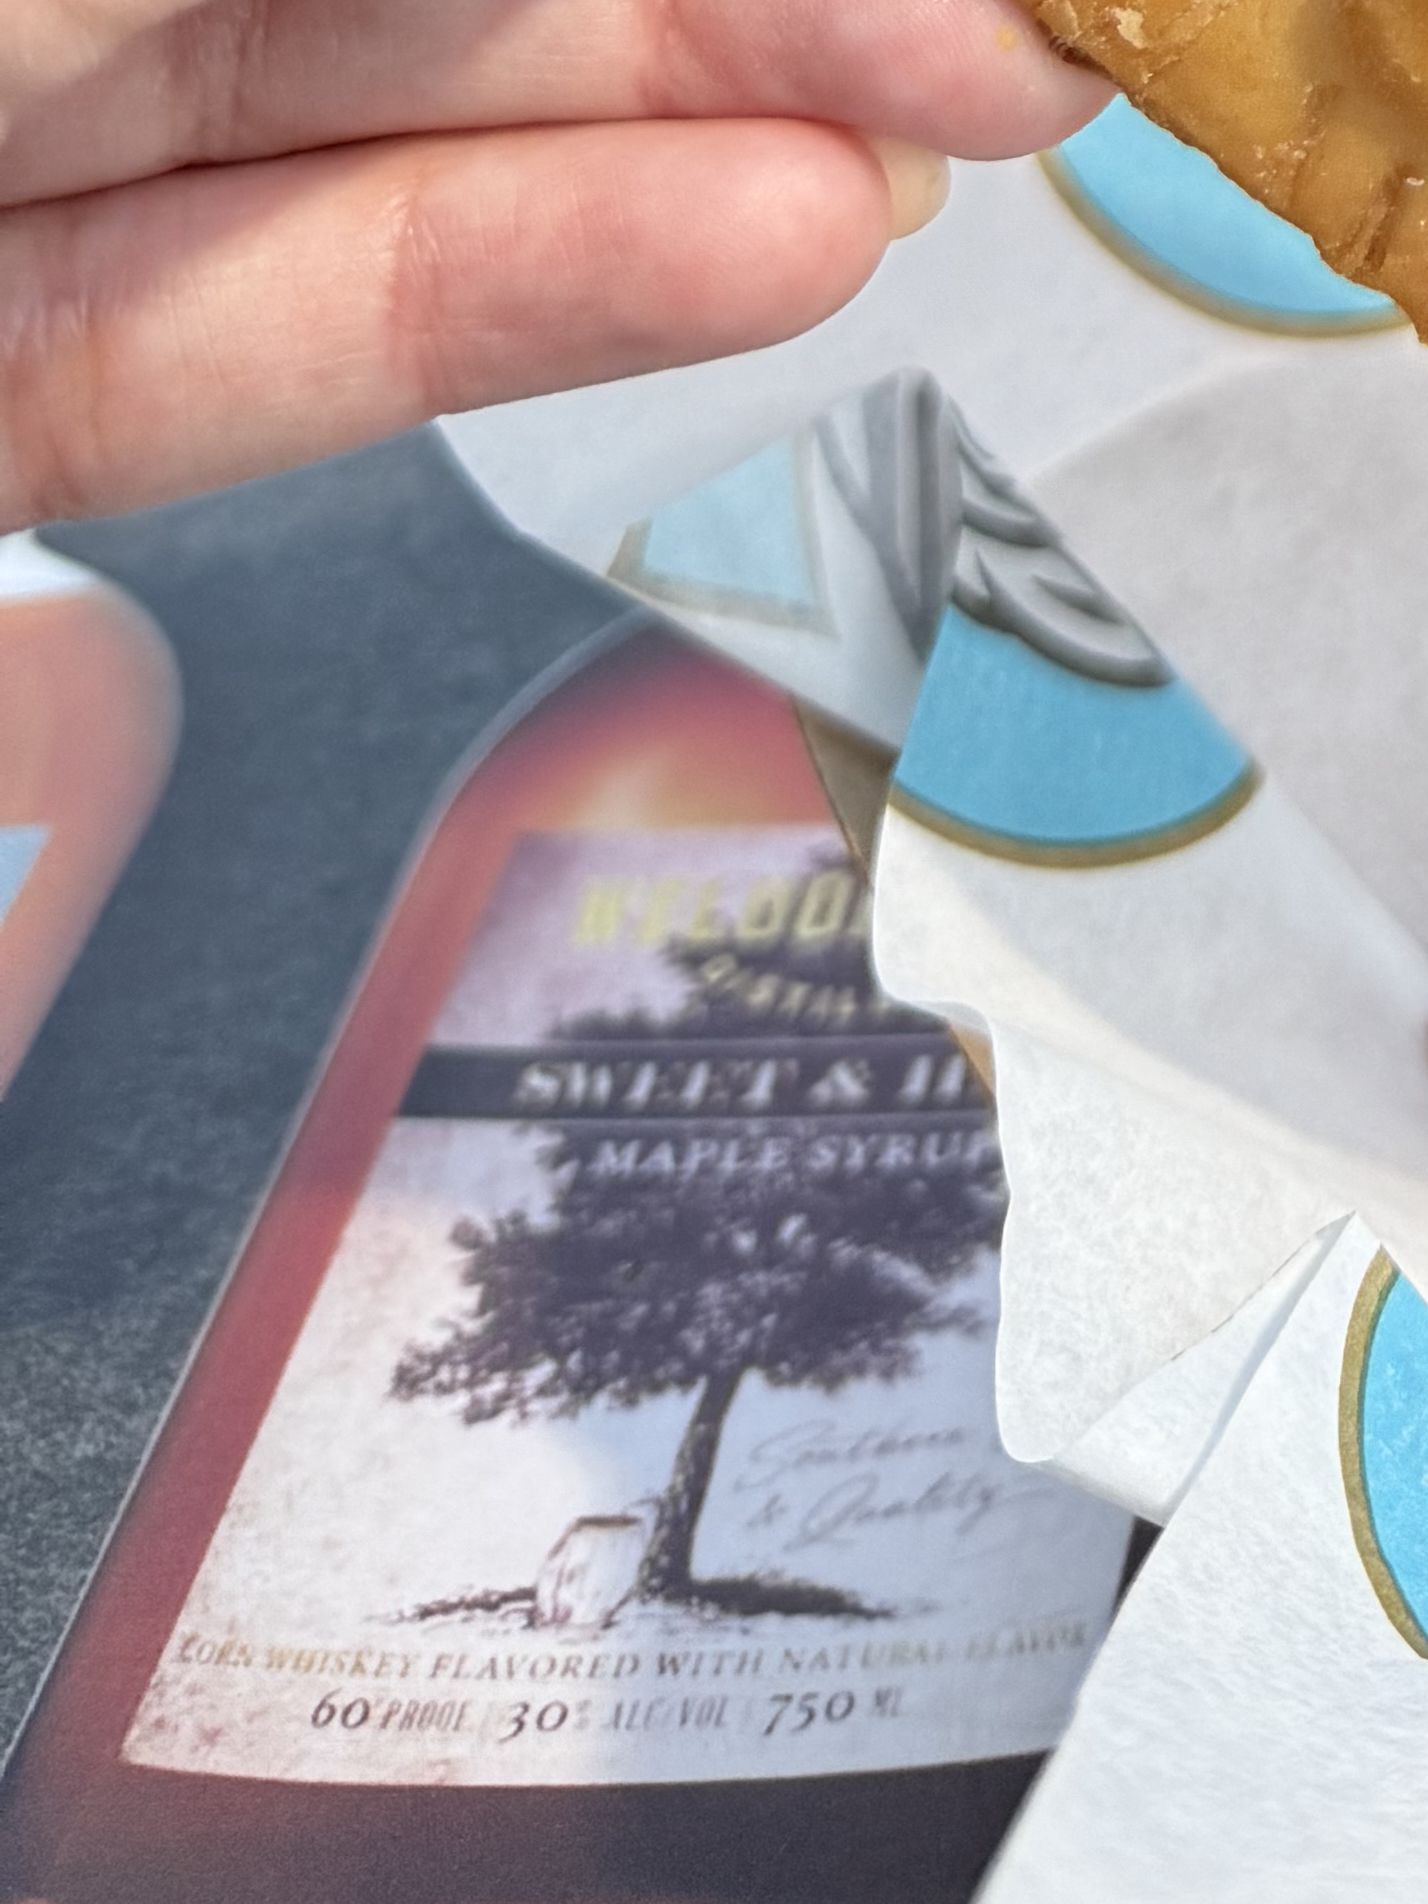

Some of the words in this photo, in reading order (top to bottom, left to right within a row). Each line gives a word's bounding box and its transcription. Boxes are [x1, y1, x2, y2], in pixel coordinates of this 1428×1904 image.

[586, 1136, 790, 1178] MAPLE
[265, 1644, 420, 1681] WHISKEY
[428, 1652, 640, 1681] FLAVORED
[654, 1646, 765, 1679] WITH
[777, 1638, 949, 1674] NATURAL
[310, 1689, 371, 1730] 60
[762, 1691, 856, 1736] 750
